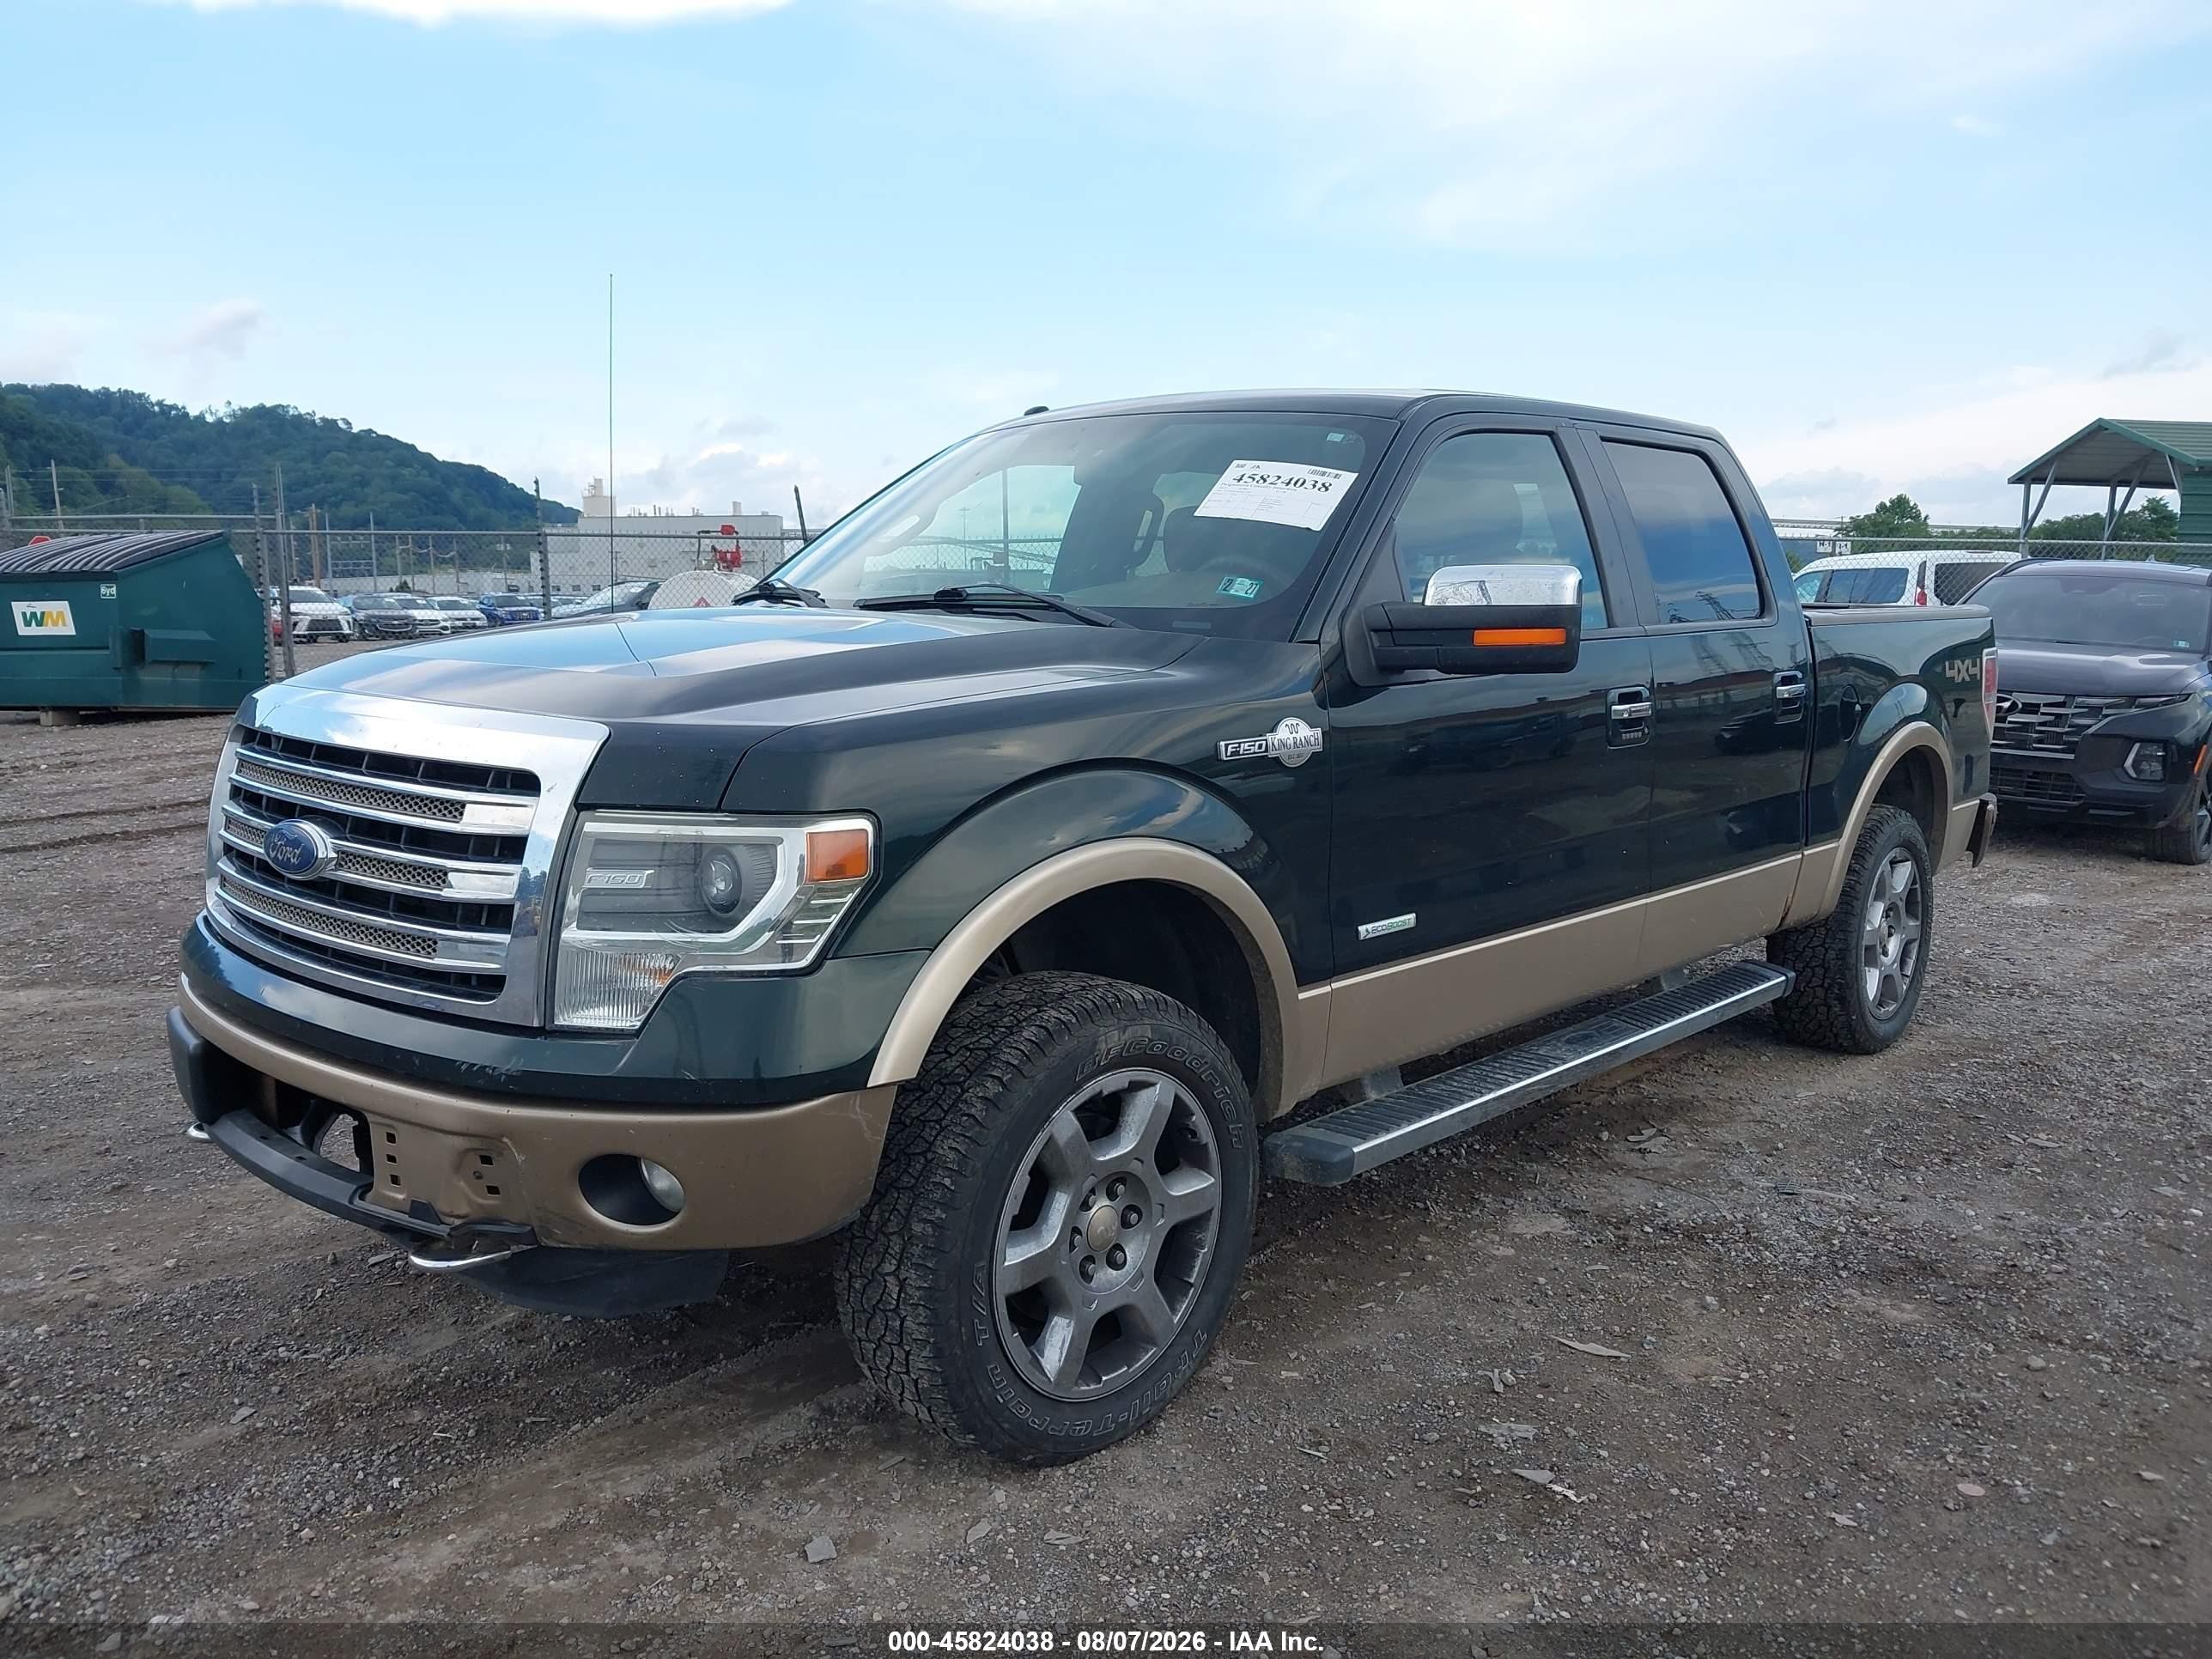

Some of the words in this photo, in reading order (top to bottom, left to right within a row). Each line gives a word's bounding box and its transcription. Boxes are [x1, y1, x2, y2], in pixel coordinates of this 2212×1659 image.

[1232, 472, 1333, 493] 45824038
[21, 611, 68, 628] WM
[1226, 741, 1267, 757] F-150
[269, 830, 306, 866] Ford
[1075, 1037, 1244, 1149] BFGoodrich
